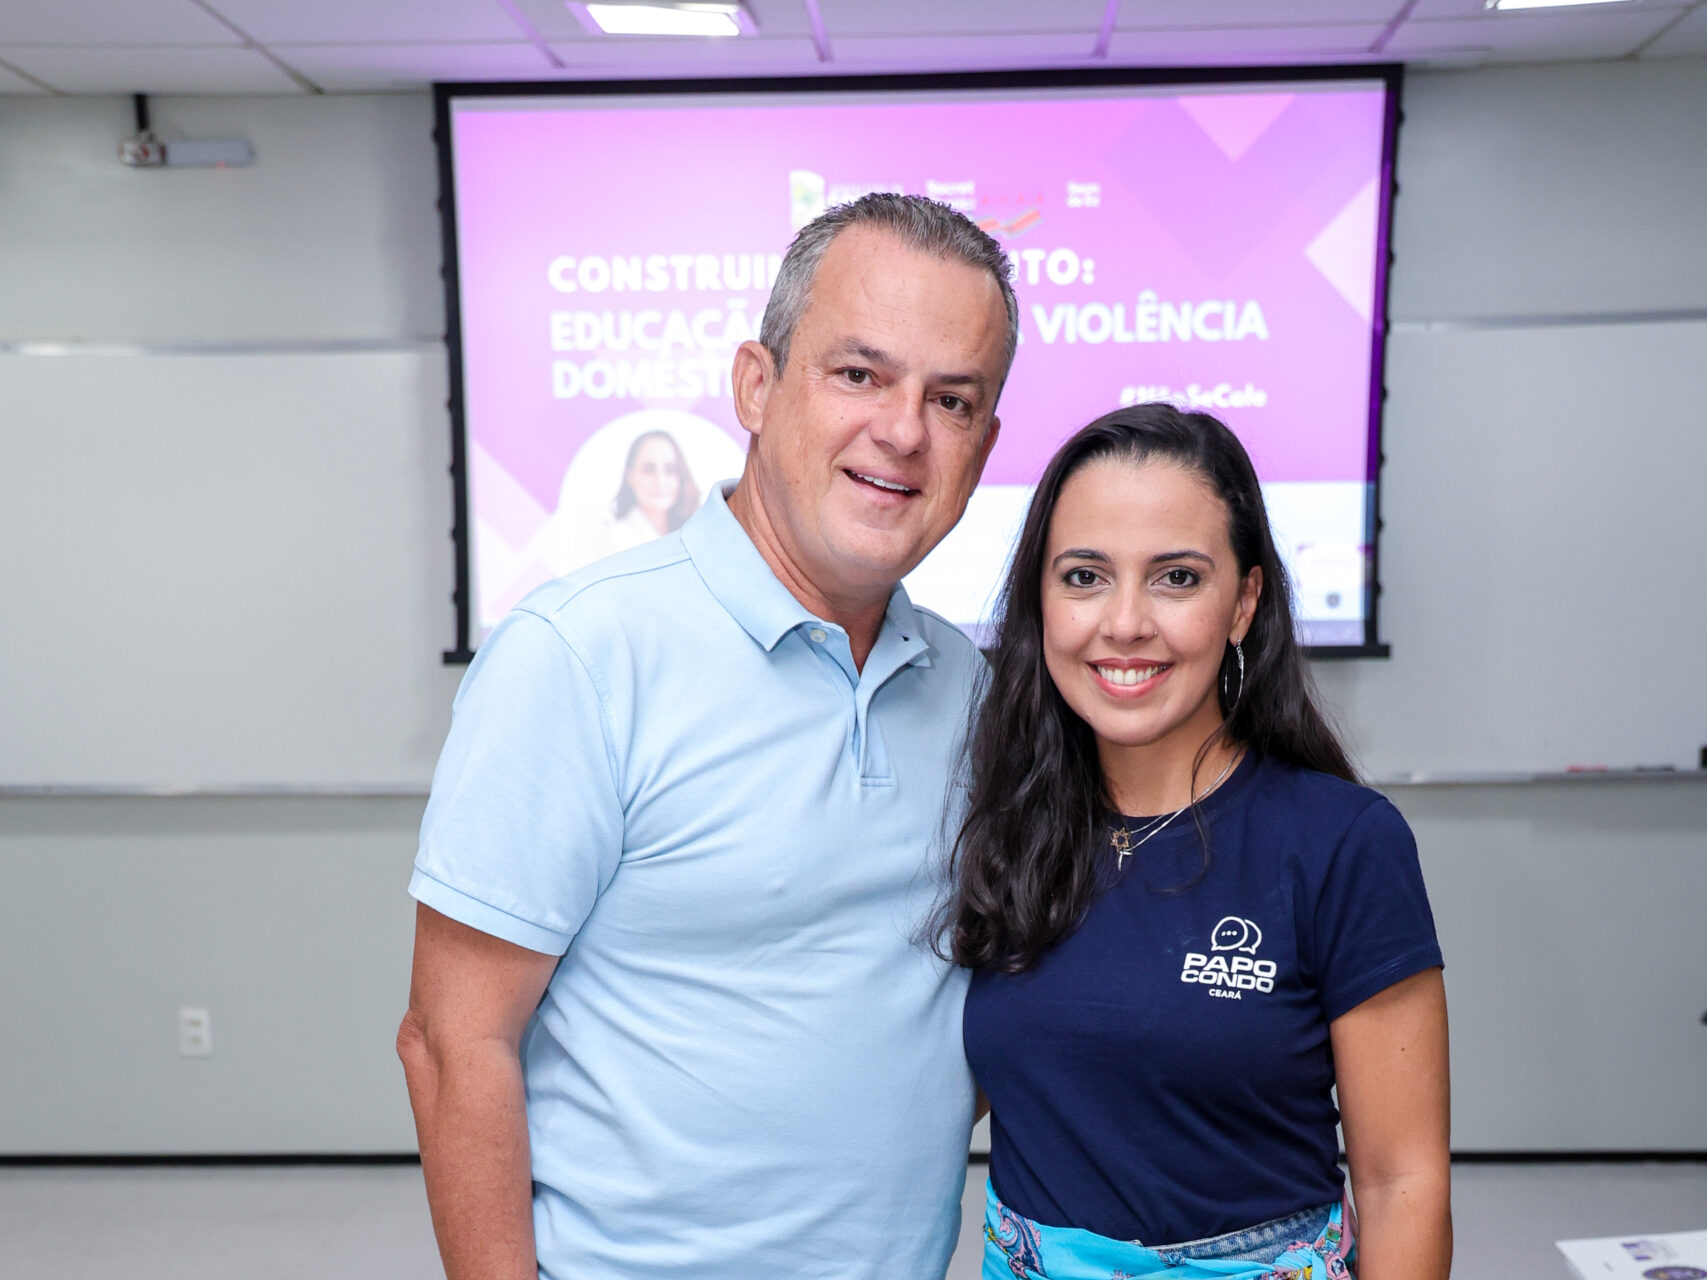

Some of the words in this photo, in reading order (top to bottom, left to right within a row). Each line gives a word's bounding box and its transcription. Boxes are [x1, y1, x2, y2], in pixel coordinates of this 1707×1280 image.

[550, 298, 764, 357] EDUCAÇÃ
[1031, 289, 1270, 344] VIOLÊNCIA
[1183, 952, 1277, 979] PAPO
[1181, 969, 1275, 994] CONDO
[1208, 988, 1242, 1000] CEARÁ
